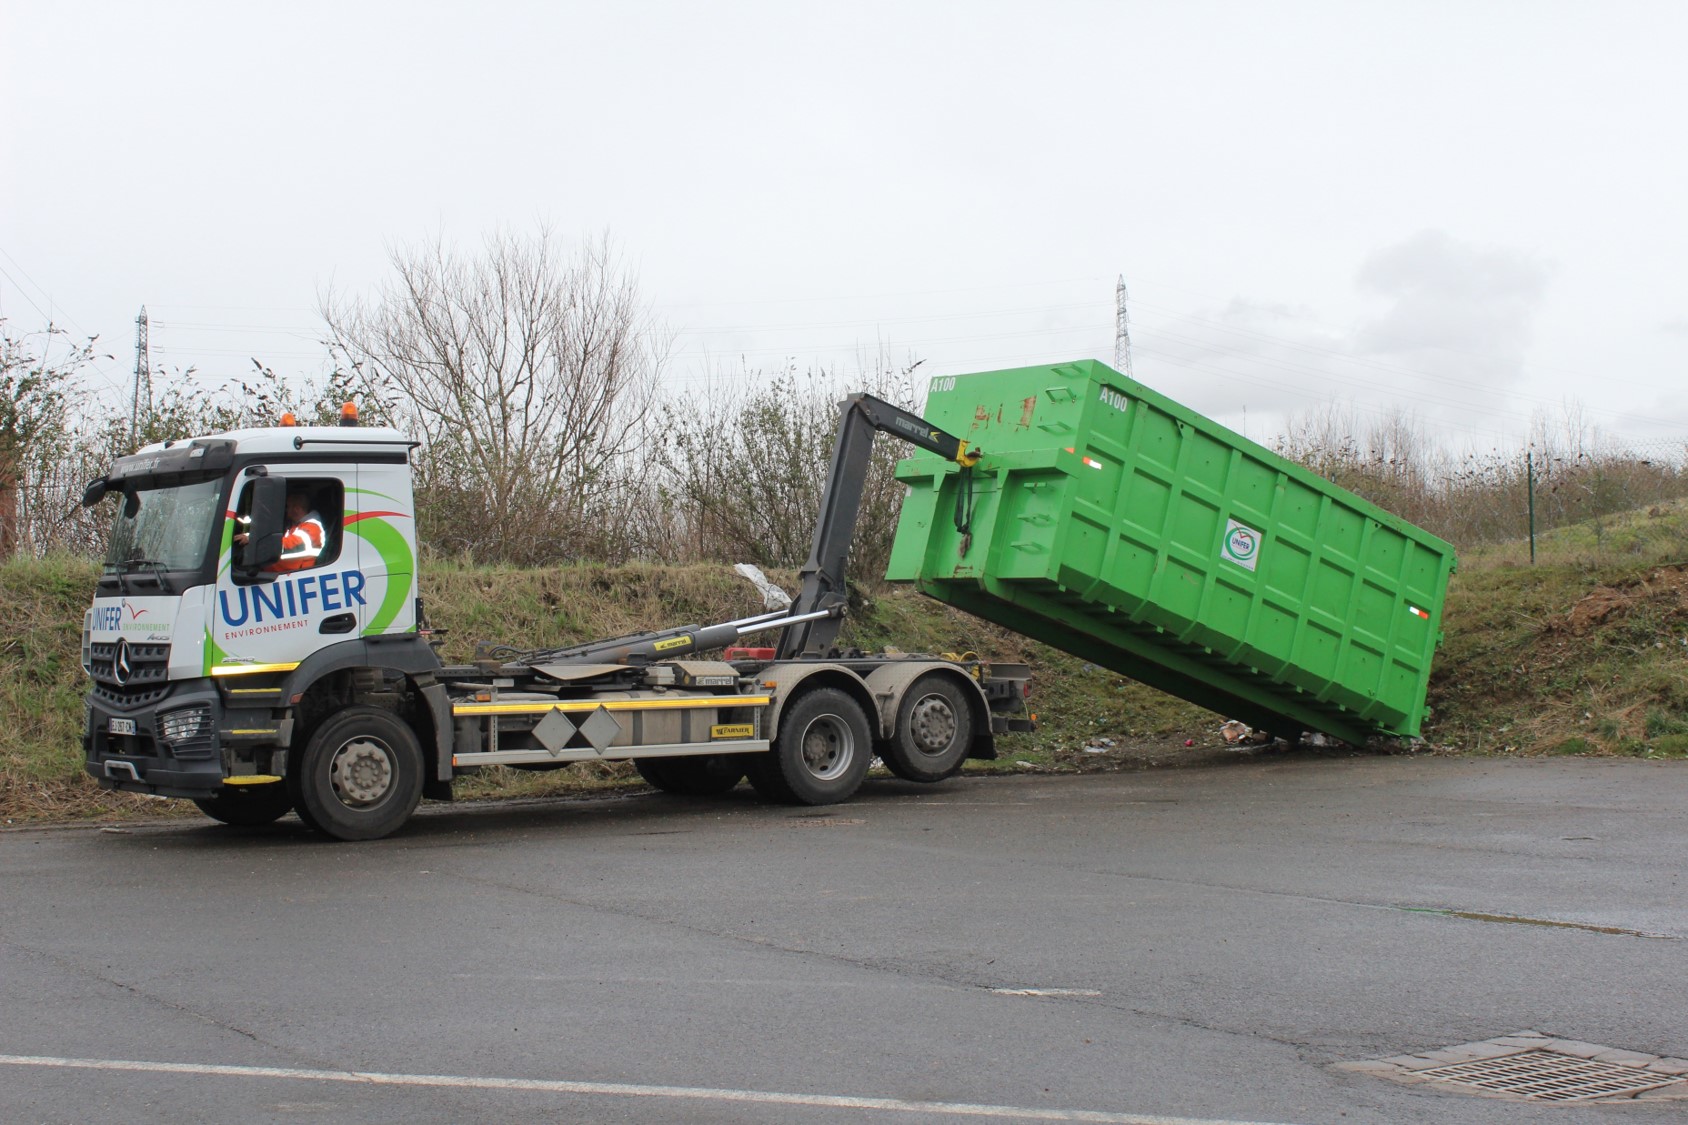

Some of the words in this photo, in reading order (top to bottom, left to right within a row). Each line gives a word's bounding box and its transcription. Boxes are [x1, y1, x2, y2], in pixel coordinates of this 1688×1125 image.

[930, 377, 956, 393] A100
[1099, 386, 1128, 412] A100
[895, 416, 929, 438] marrel
[1231, 537, 1250, 549] UNIFER
[219, 570, 367, 627] UNIFER
[93, 607, 121, 631] UNIFER
[123, 623, 170, 631] ENVIRONNEMENT
[225, 619, 309, 640] ENVIRONNEMENT
[705, 677, 732, 685] marrel
